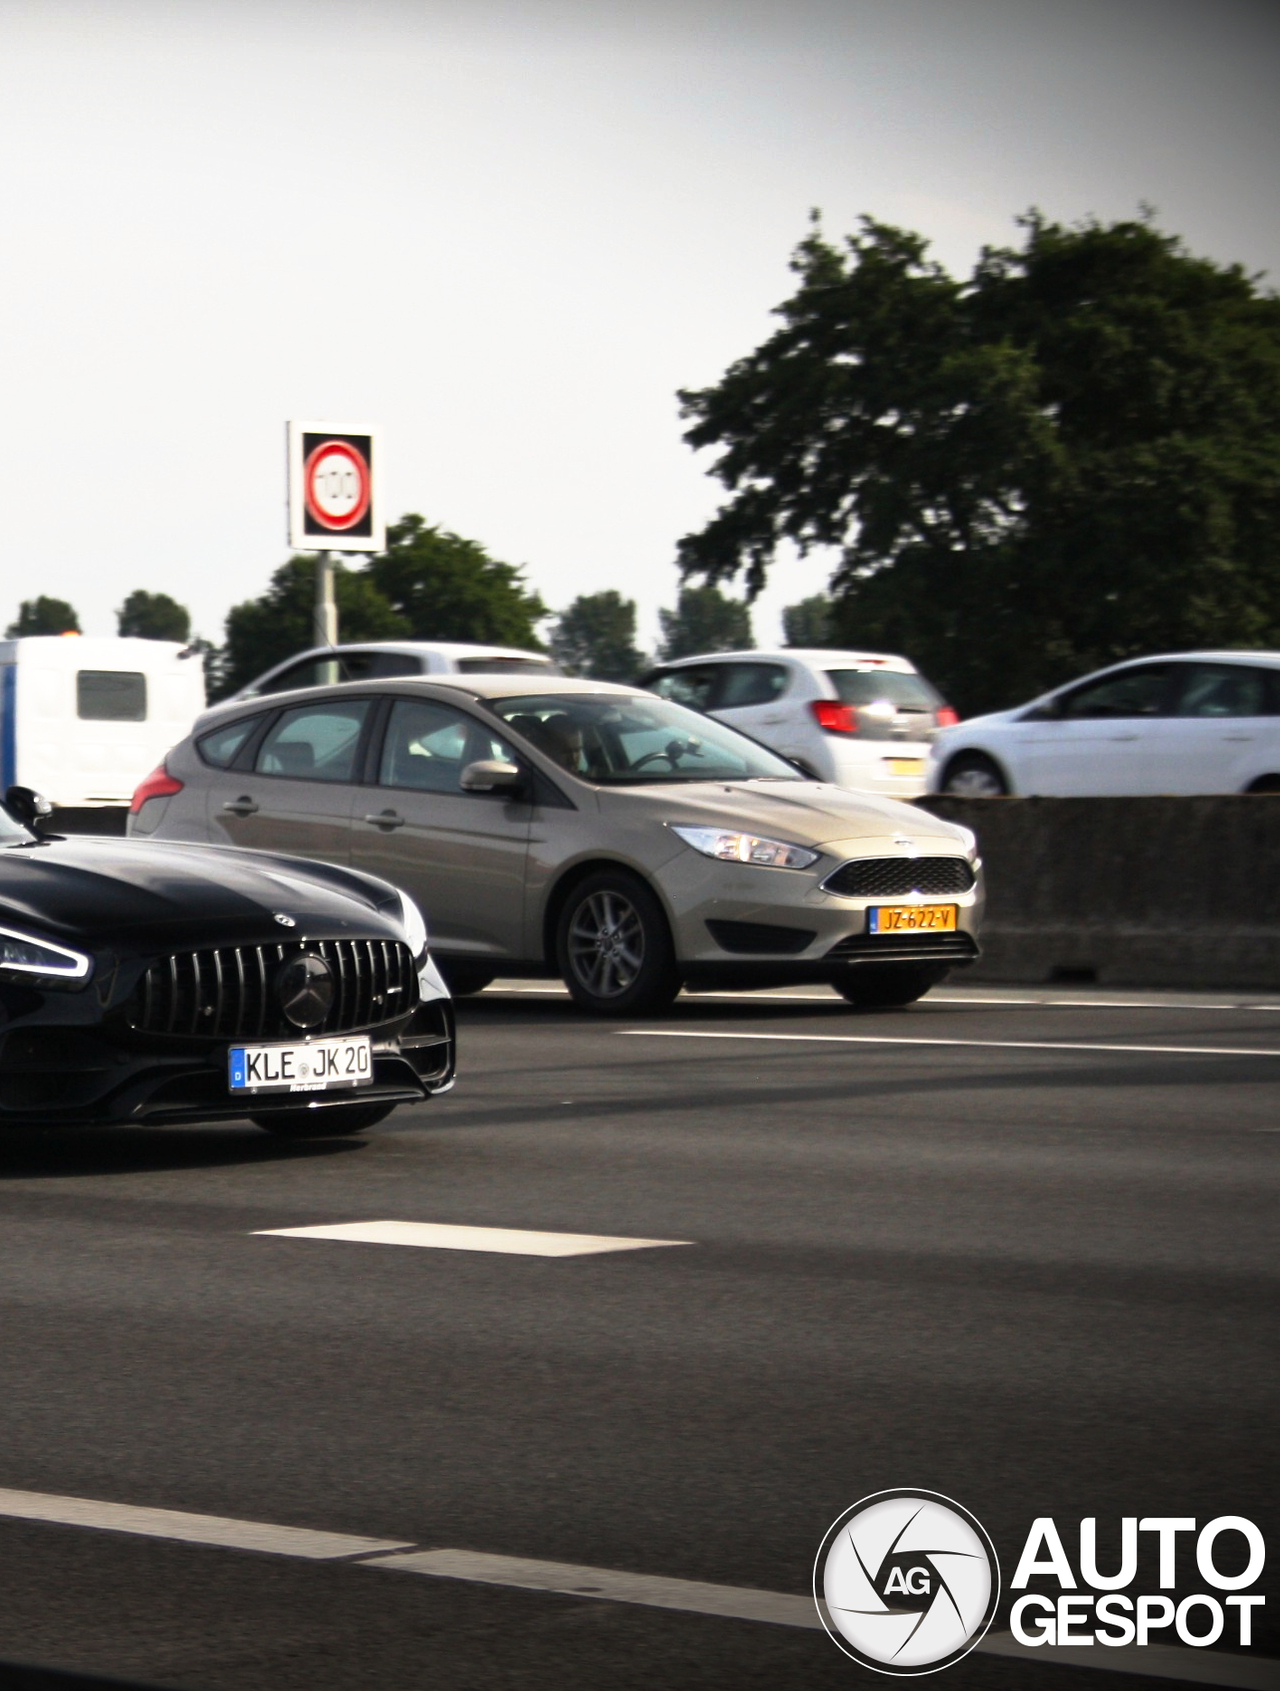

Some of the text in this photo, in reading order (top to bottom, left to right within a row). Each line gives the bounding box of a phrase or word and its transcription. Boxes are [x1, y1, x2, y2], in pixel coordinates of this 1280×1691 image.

[885, 908, 950, 930] JZ-622-V
[246, 1045, 369, 1082] KLE JK 20
[234, 1072, 242, 1081] D
